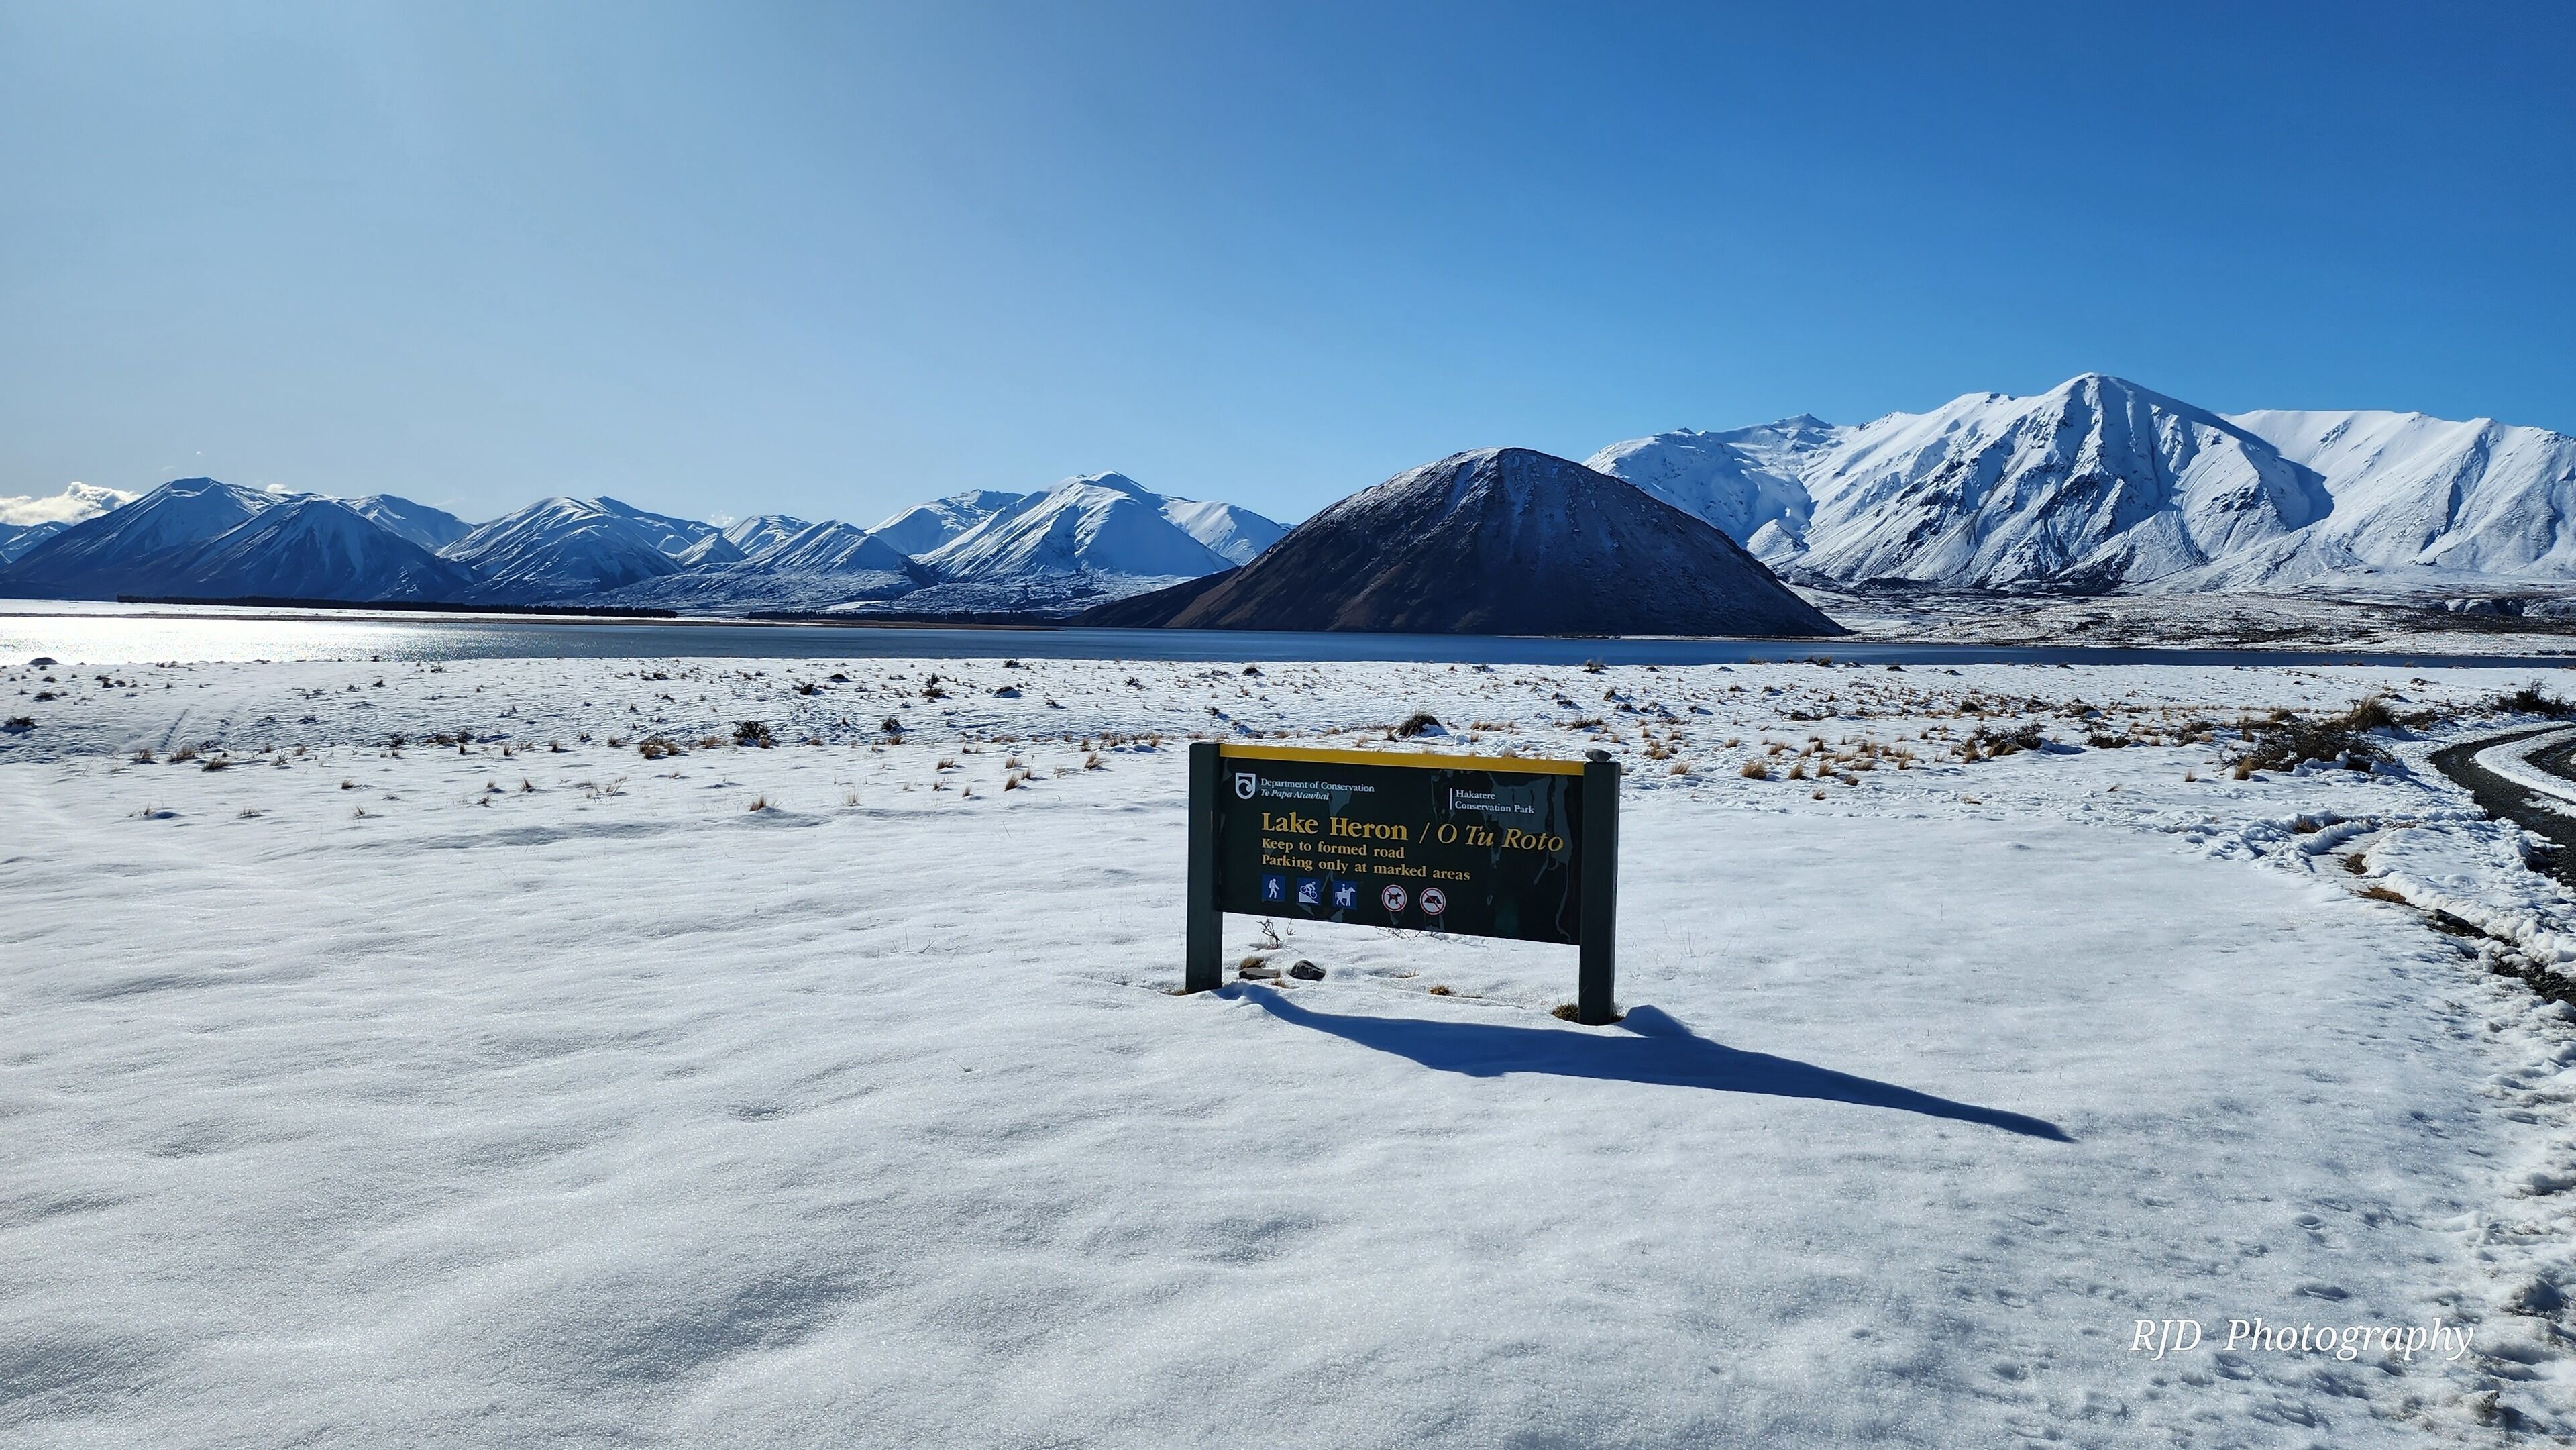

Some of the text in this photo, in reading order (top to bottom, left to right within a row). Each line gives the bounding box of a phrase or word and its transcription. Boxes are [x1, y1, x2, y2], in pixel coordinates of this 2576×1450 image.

[1260, 778, 1375, 792] Department of Conservation
[1271, 790, 1292, 799] Papa
[1455, 790, 1495, 800] Hakatere
[1455, 800, 1534, 813] Conservation Park
[1261, 811, 1564, 852] Lake Heron / O Tu Roto
[1262, 838, 1405, 859] Keep to formed road
[1262, 854, 1470, 881] Parking only at marked areas
